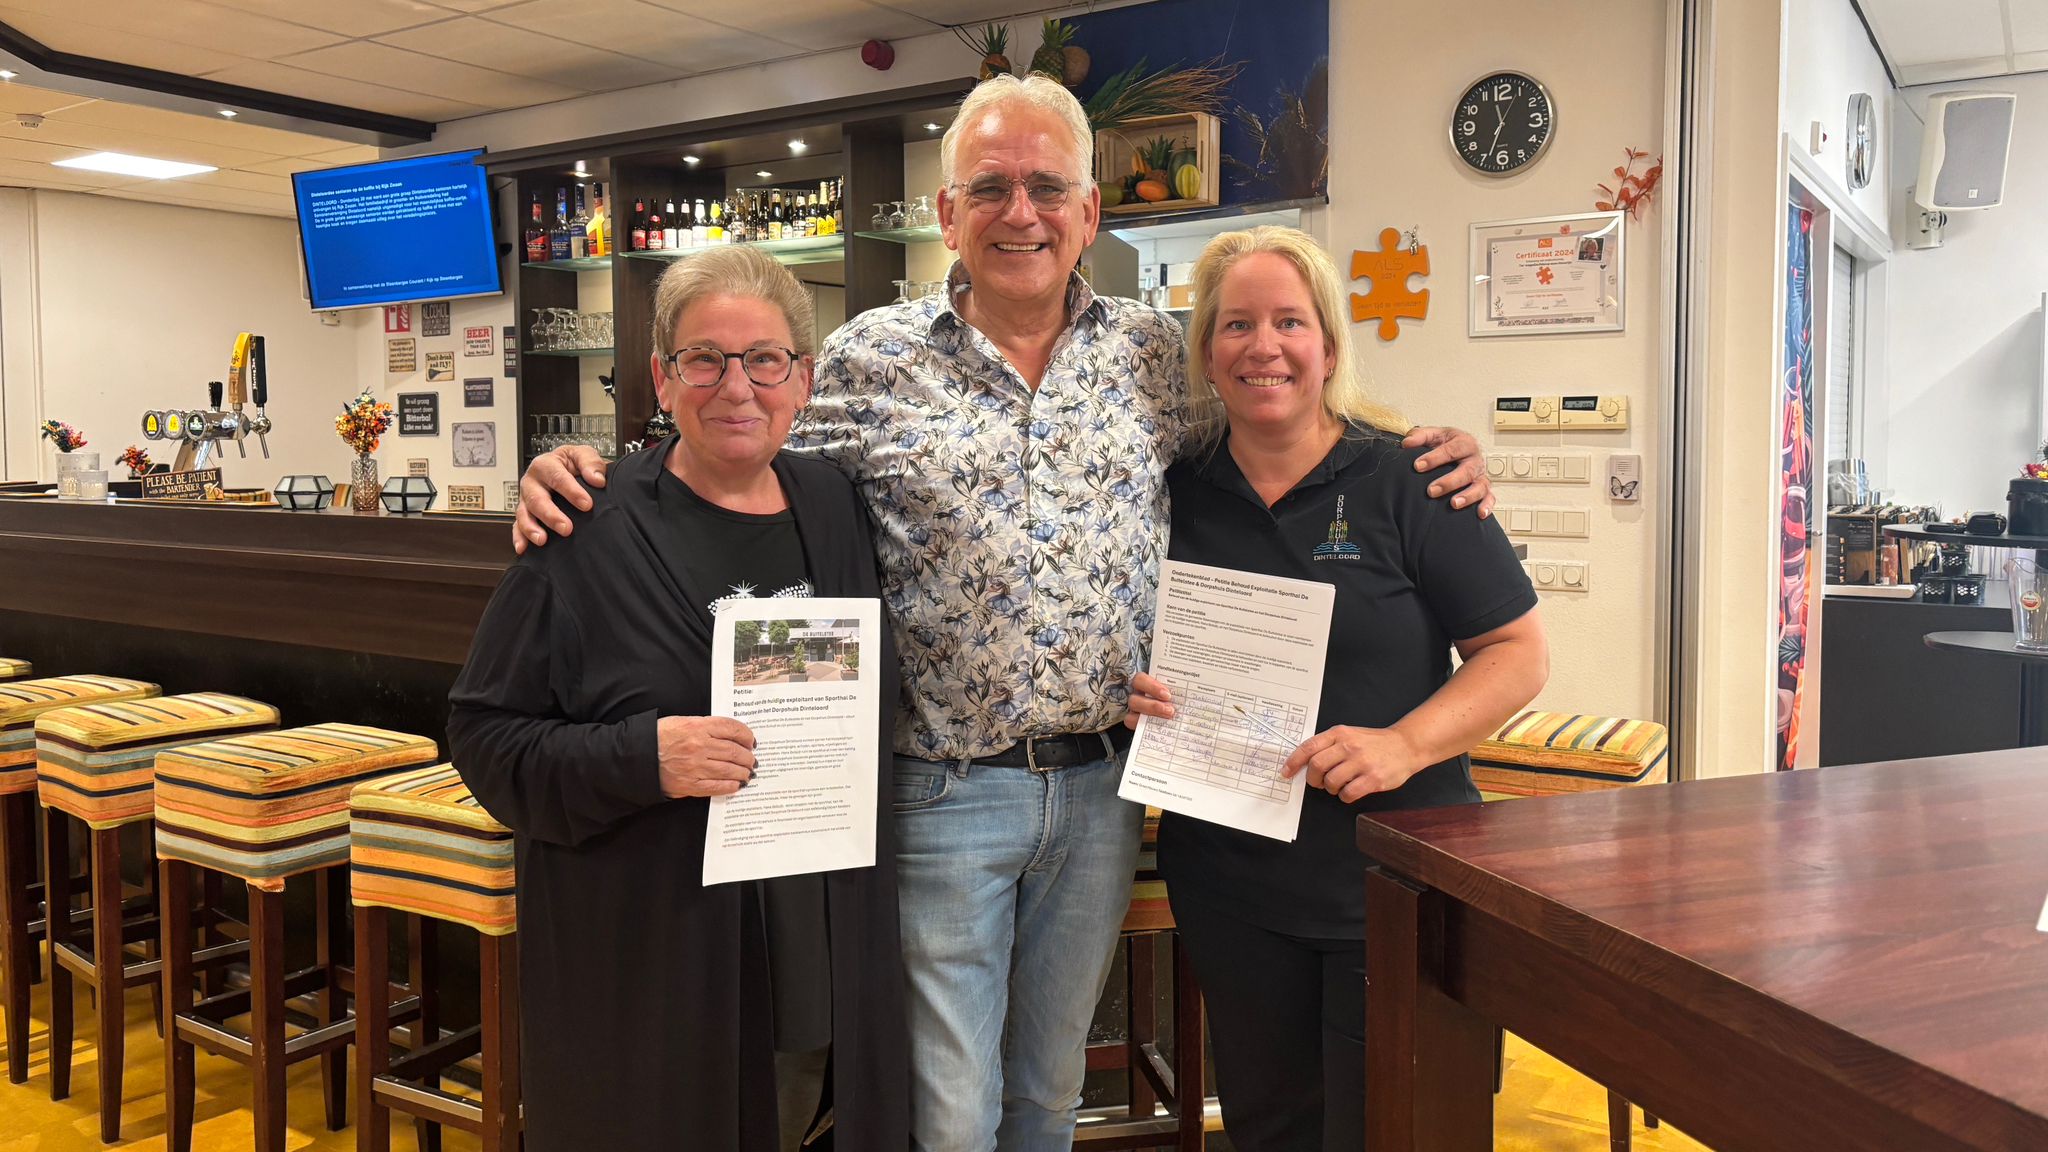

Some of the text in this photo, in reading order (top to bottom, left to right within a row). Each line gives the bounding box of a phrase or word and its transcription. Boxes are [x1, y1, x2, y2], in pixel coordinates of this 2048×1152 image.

[1483, 91, 1488, 101] 11
[1494, 84, 1512, 101] 12
[1519, 87, 1521, 96] 1
[1528, 97, 1536, 107] 2
[1468, 105, 1478, 115] 10
[1528, 113, 1543, 127] 3
[1463, 121, 1475, 135] 9
[1469, 142, 1477, 150] 8
[1481, 154, 1487, 163] 7
[1496, 151, 1508, 165] 6
[1518, 150, 1524, 158] 5
[1516, 251, 1552, 259] Certificaat
[467, 328, 490, 338] BEER
[146, 471, 216, 487] PLEASE BE PATIENT
[167, 483, 201, 494] BARTENDER
[1334, 494, 1344, 552] DORPSHUIS
[1172, 569, 1210, 581] Ondertekenblad
[1215, 577, 1230, 585] Petitie
[1231, 580, 1250, 589] Behoud
[1251, 584, 1277, 594] Exploitatie
[1279, 589, 1300, 598] Sporthal
[1200, 582, 1225, 592] Dorpshuis
[1226, 587, 1252, 597] Dinteloord
[1163, 629, 1195, 640] Verzoekpunten
[825, 694, 848, 702] Sporthal
[772, 705, 799, 713] Dorpshuis
[800, 703, 828, 712] Dinteloord
[1131, 770, 1167, 784] Contactpersoon
